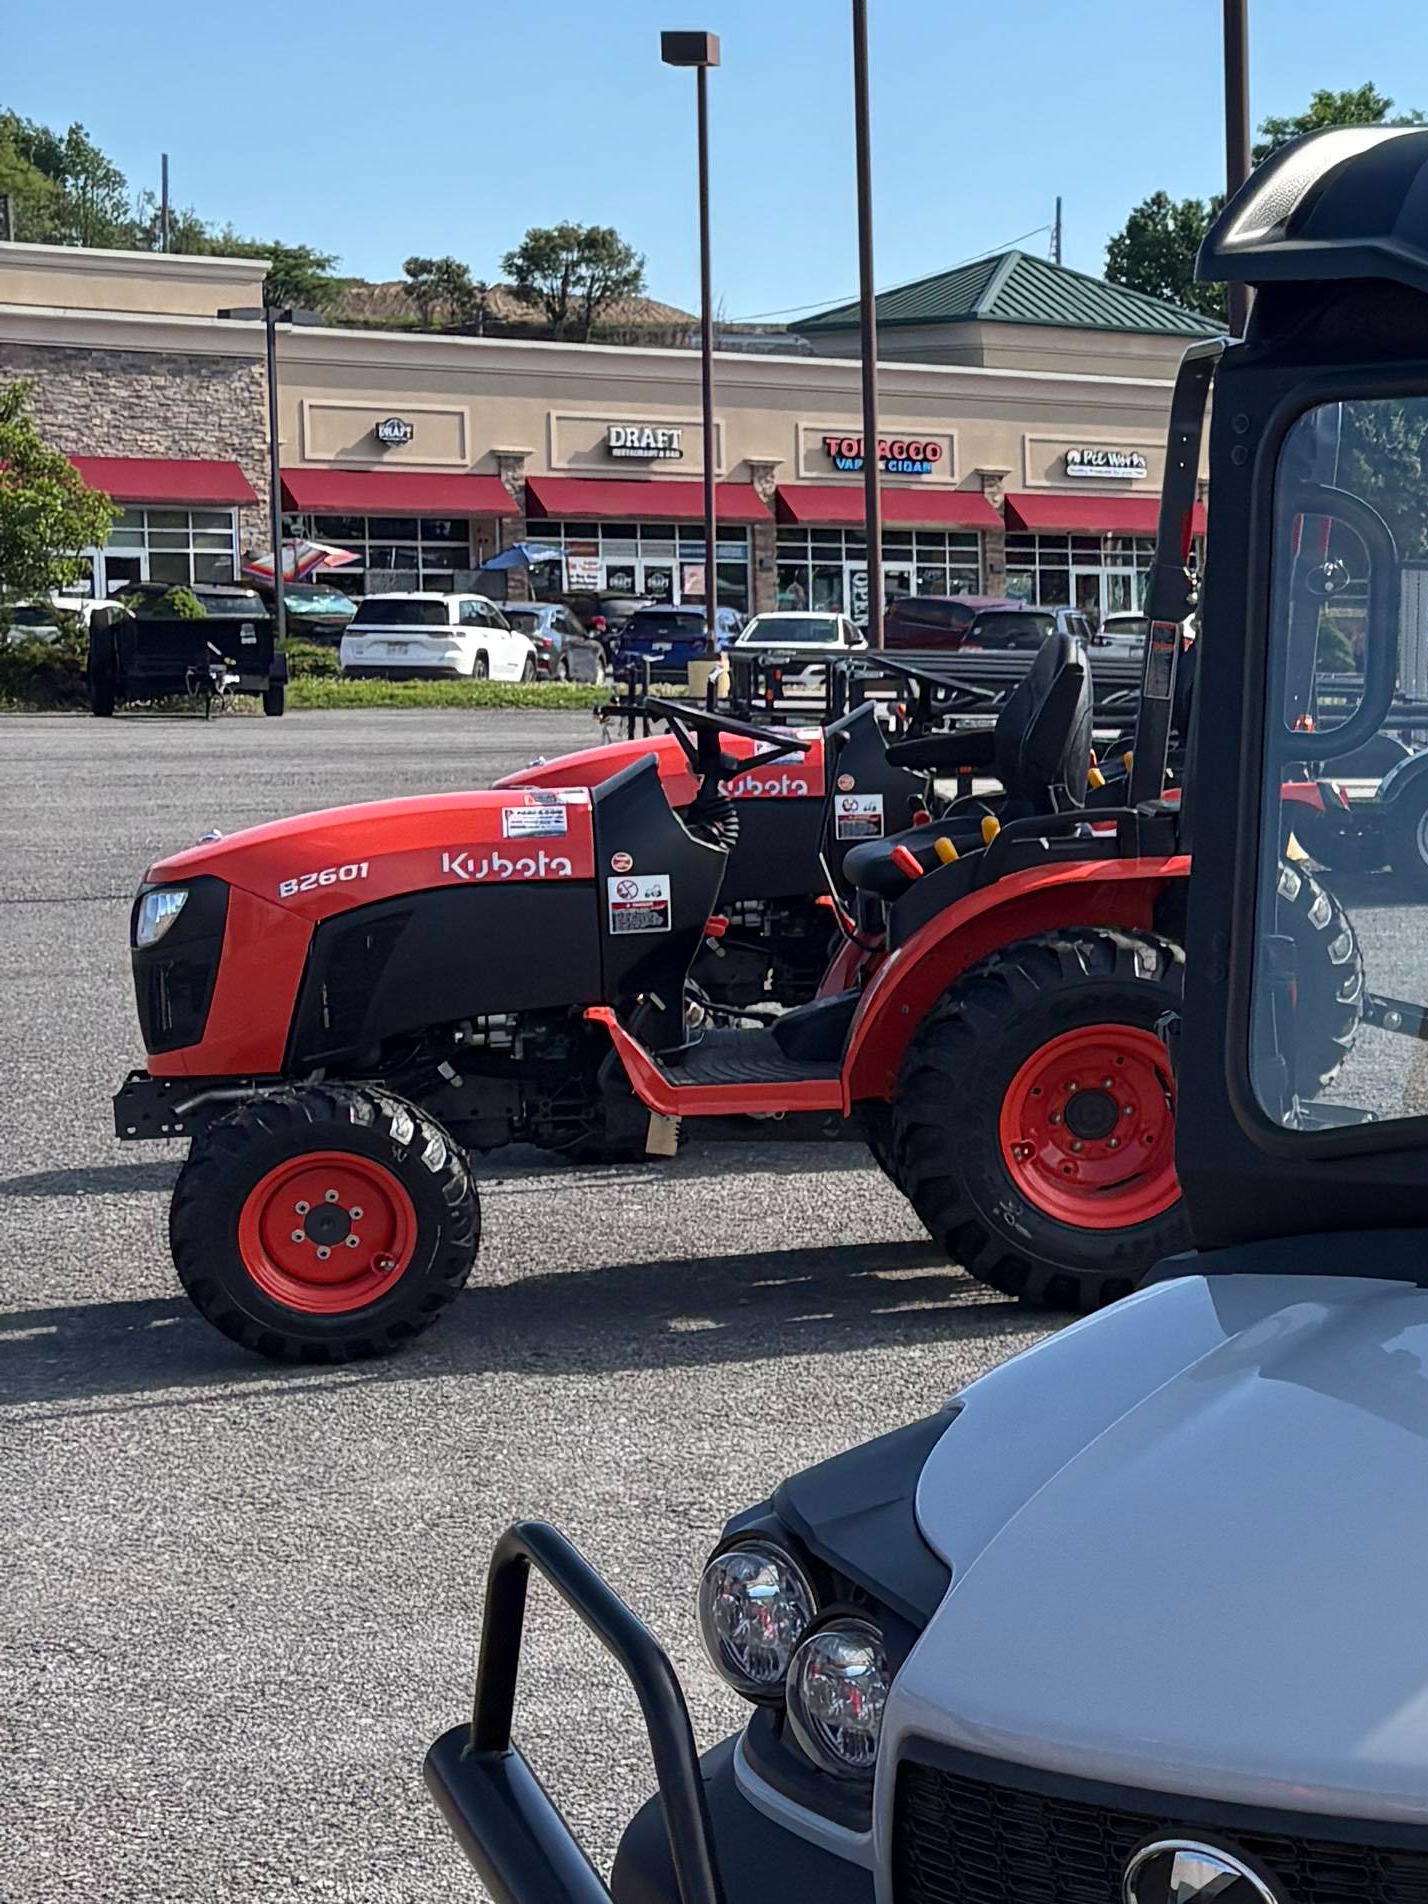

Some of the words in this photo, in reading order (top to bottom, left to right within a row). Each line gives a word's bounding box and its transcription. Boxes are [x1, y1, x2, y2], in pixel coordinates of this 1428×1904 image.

[609, 426, 682, 449] DRAFT
[824, 437, 943, 460] TOACCO
[835, 457, 864, 470] VAP
[441, 849, 572, 880] Kubota
[279, 861, 369, 899] B2601
